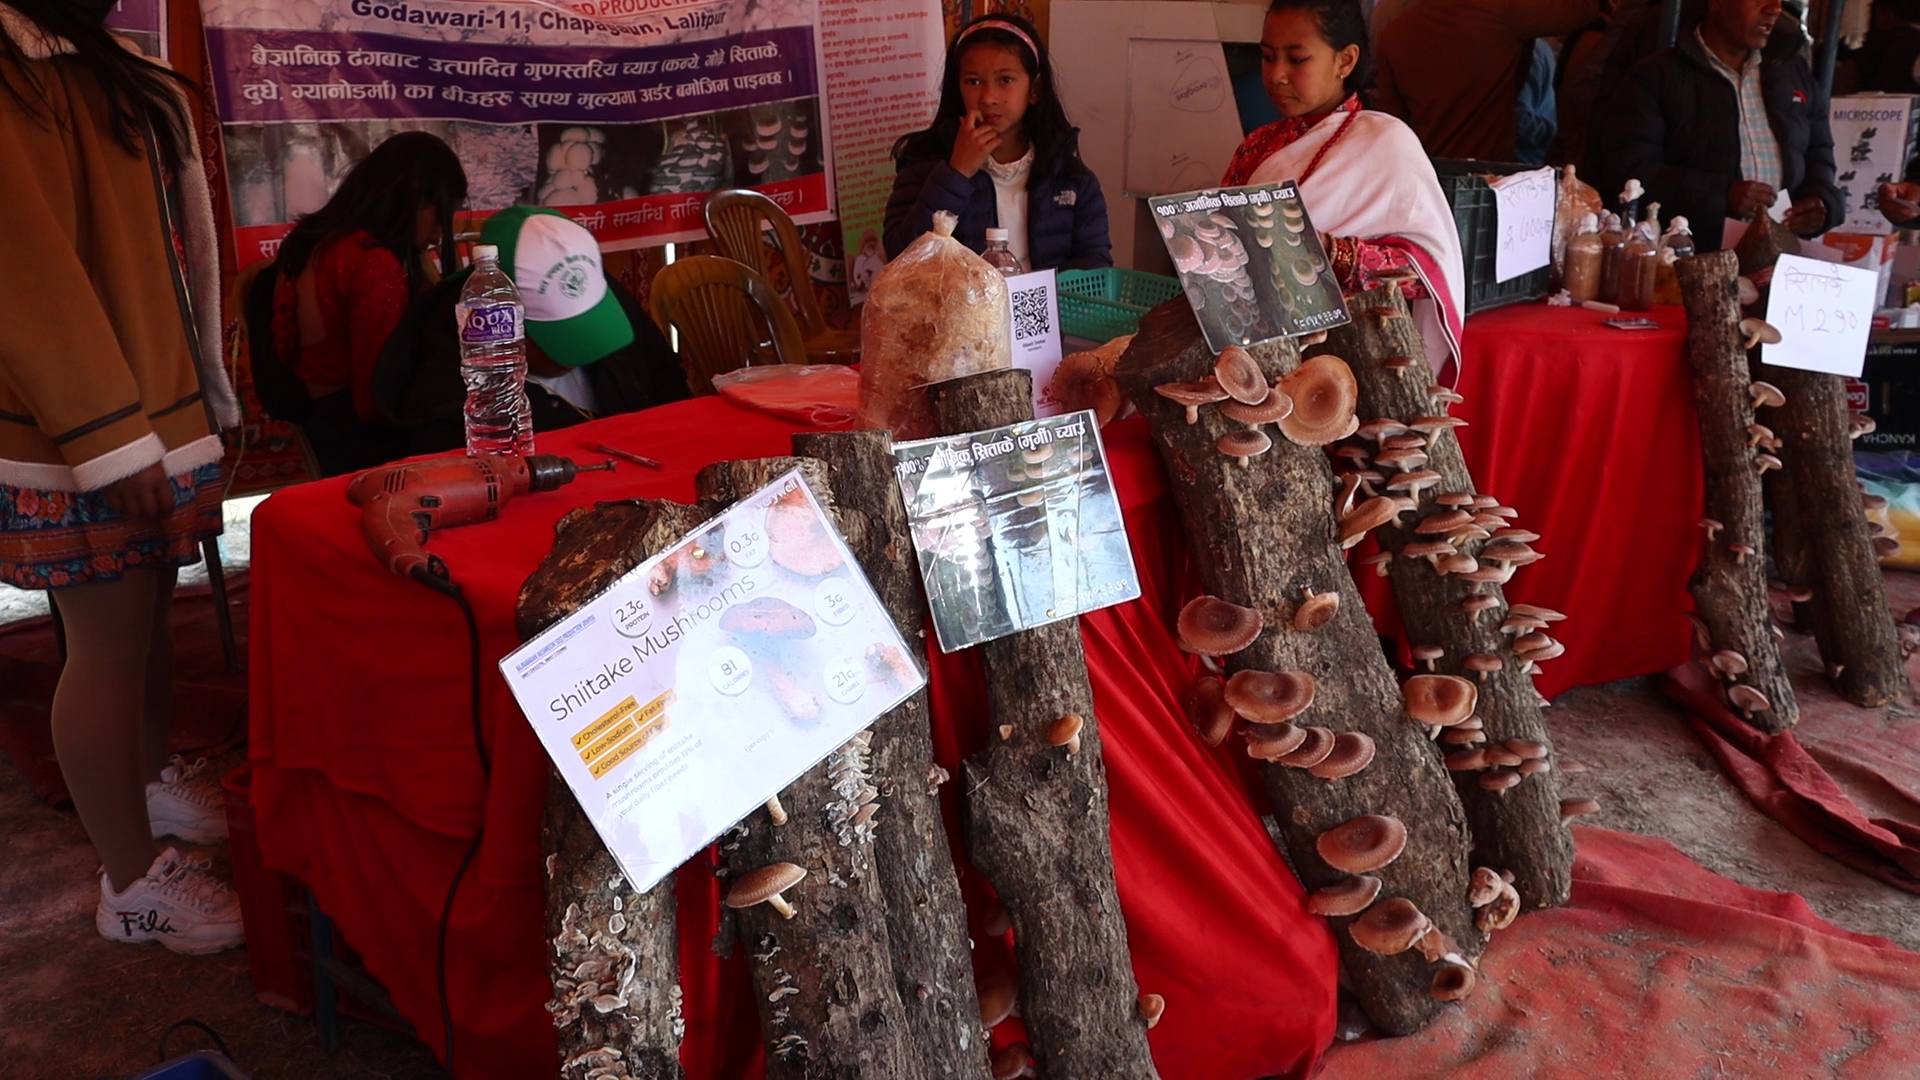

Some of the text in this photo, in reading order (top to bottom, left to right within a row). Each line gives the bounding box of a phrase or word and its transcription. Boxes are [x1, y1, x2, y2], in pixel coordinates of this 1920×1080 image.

[538, 11, 663, 37] Chapagaun,
[663, 10, 727, 31] Lalitpur
[347, 48, 421, 69] ढंगबाट
[428, 56, 518, 78] उत्पादित
[622, 60, 660, 75] च्याउ
[403, 82, 435, 100] का
[520, 90, 573, 109] सुपथ
[639, 82, 673, 103] अर्डर
[676, 78, 730, 99] बमोजिम
[733, 70, 783, 91] पाइन्छ
[1833, 110, 1903, 121] MICROSCOPE
[755, 477, 798, 511] verywell
[744, 549, 757, 560] FAT
[624, 611, 650, 631] PROTEIN
[549, 656, 634, 721] Shiitake
[632, 574, 756, 664] Mushrooms
[720, 658, 739, 677] 81
[722, 669, 751, 691] CALORIES
[582, 699, 637, 741] Cholesterol-Free
[591, 722, 634, 756] Low-Sodium
[600, 754, 620, 771] Good
[618, 738, 643, 758] Source
[642, 730, 652, 745] of
[605, 791, 613, 801] A
[612, 776, 634, 795] single
[633, 758, 660, 779] serving
[666, 732, 694, 755] shiitake
[611, 777, 653, 809] mushrooms
[652, 755, 682, 780] provides
[617, 762, 690, 821] your daily fiber needs
